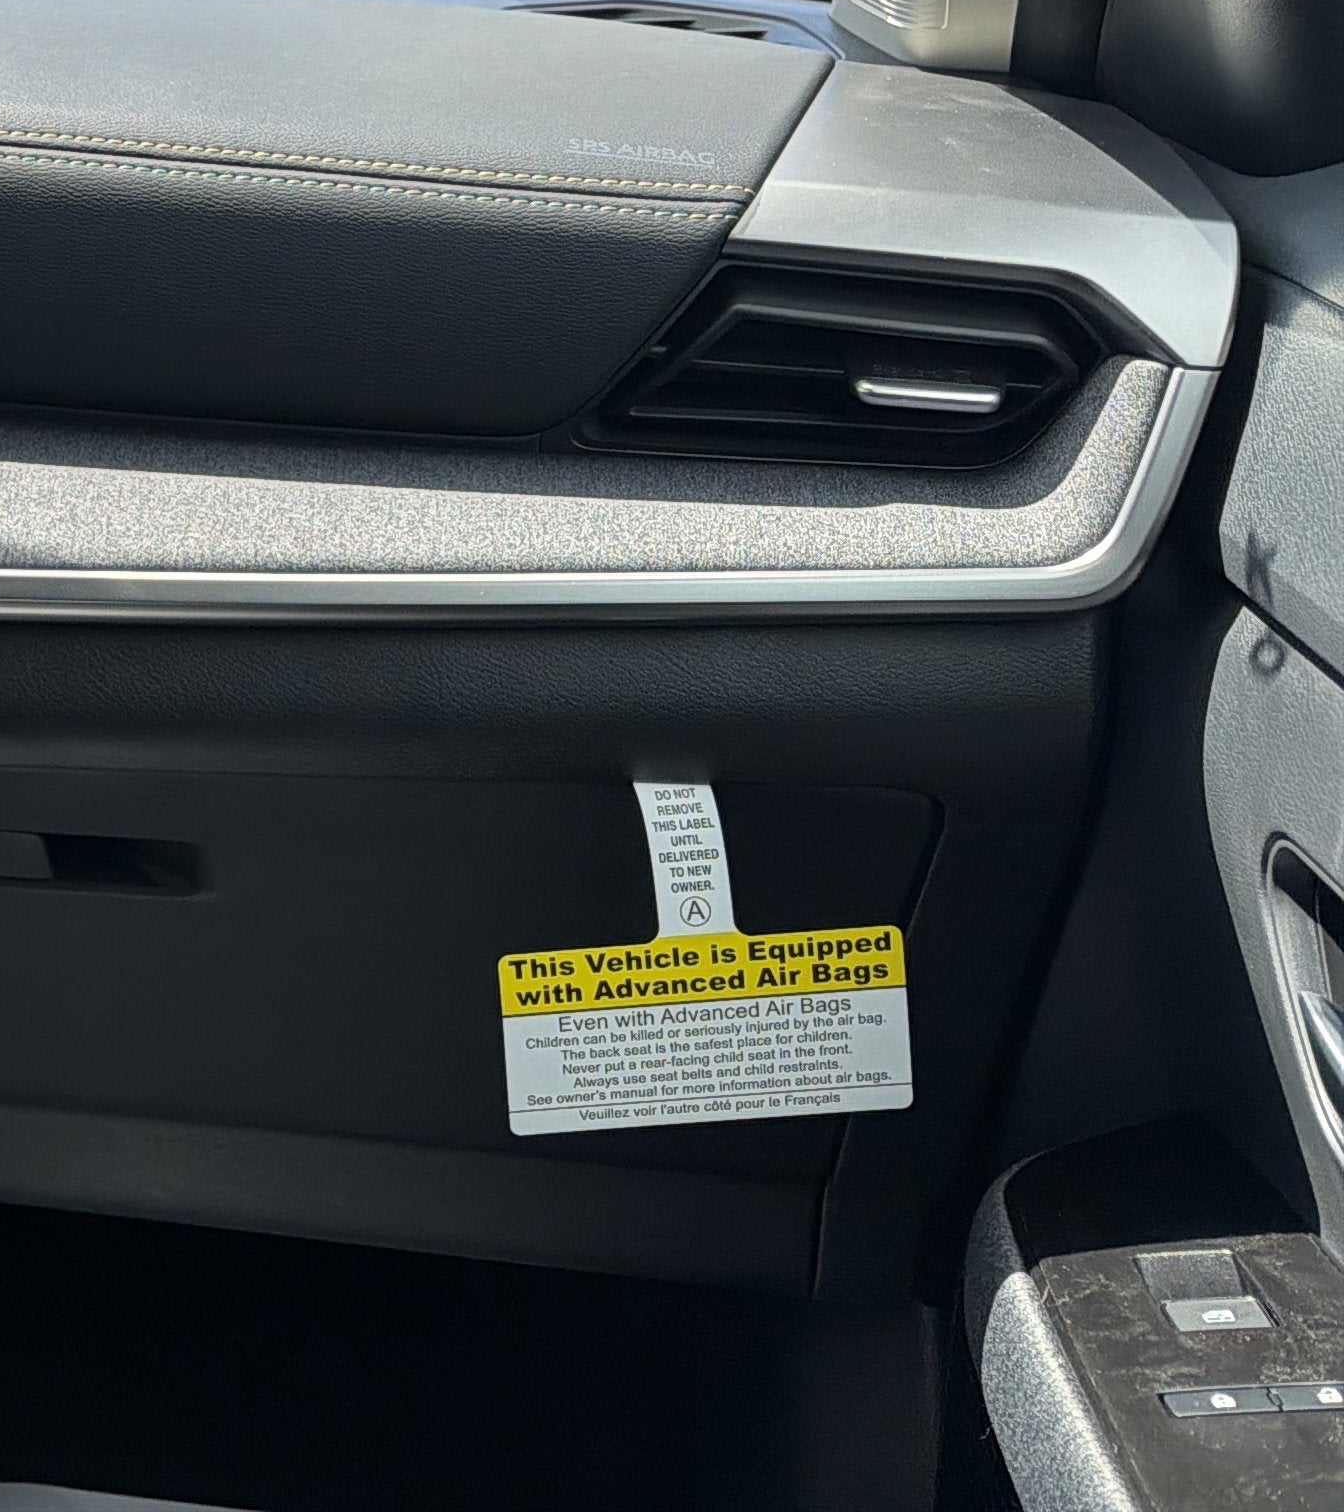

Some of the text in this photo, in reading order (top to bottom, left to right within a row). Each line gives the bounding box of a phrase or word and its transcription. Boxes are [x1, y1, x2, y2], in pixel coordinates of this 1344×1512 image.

[654, 787, 696, 801] DO NOT
[657, 802, 704, 816] REMOVE
[652, 817, 715, 833] THIS LABEL
[670, 834, 703, 847] UNTIL
[658, 848, 719, 863] DELIVERED
[669, 864, 712, 878] TO NEW
[670, 880, 715, 893] OWNER.
[686, 900, 706, 921] A
[508, 931, 892, 981] This Vehicle is Equipped
[516, 963, 889, 1007] with Advanced Air Bags
[558, 997, 852, 1034] Even with Advanced Air Bags
[525, 1035, 580, 1051] Children
[582, 1034, 608, 1046] can
[609, 1031, 627, 1044] be
[629, 1027, 664, 1042] killed
[667, 1028, 682, 1040] or
[684, 1022, 743, 1039] seriously
[745, 1018, 791, 1036] injured
[793, 1017, 810, 1032] by
[813, 1015, 833, 1029] the
[837, 1014, 854, 1027] air
[560, 1049, 587, 1062] The
[589, 1045, 622, 1060] back
[623, 1043, 653, 1058] seat
[655, 1042, 667, 1055] is
[669, 1041, 691, 1054] the
[693, 1037, 735, 1052] safest
[736, 1035, 773, 1051] place
[775, 1033, 794, 1046] for
[562, 1063, 602, 1076] Never
[604, 1059, 626, 1076] put
[628, 1061, 638, 1071] a
[640, 1054, 711, 1070] rear-facing
[713, 1050, 745, 1065] child
[747, 1048, 777, 1063] seat
[779, 1047, 792, 1061] in
[794, 1046, 816, 1059] the
[526, 1094, 554, 1107] See
[556, 1089, 608, 1105] owner's
[610, 1085, 659, 1101] manual
[660, 1084, 680, 1097] for
[682, 1083, 716, 1096] more
[718, 1077, 792, 1093] information
[794, 1073, 834, 1088] about
[835, 1071, 854, 1085] air
[573, 1076, 620, 1090] Always
[622, 1074, 647, 1086] use
[650, 1070, 679, 1084] seat
[681, 1067, 714, 1082] belts
[716, 1065, 741, 1079] and
[744, 1062, 776, 1077] child
[579, 1091, 842, 1122] Veuillez voir l'autre côté pour le Français
